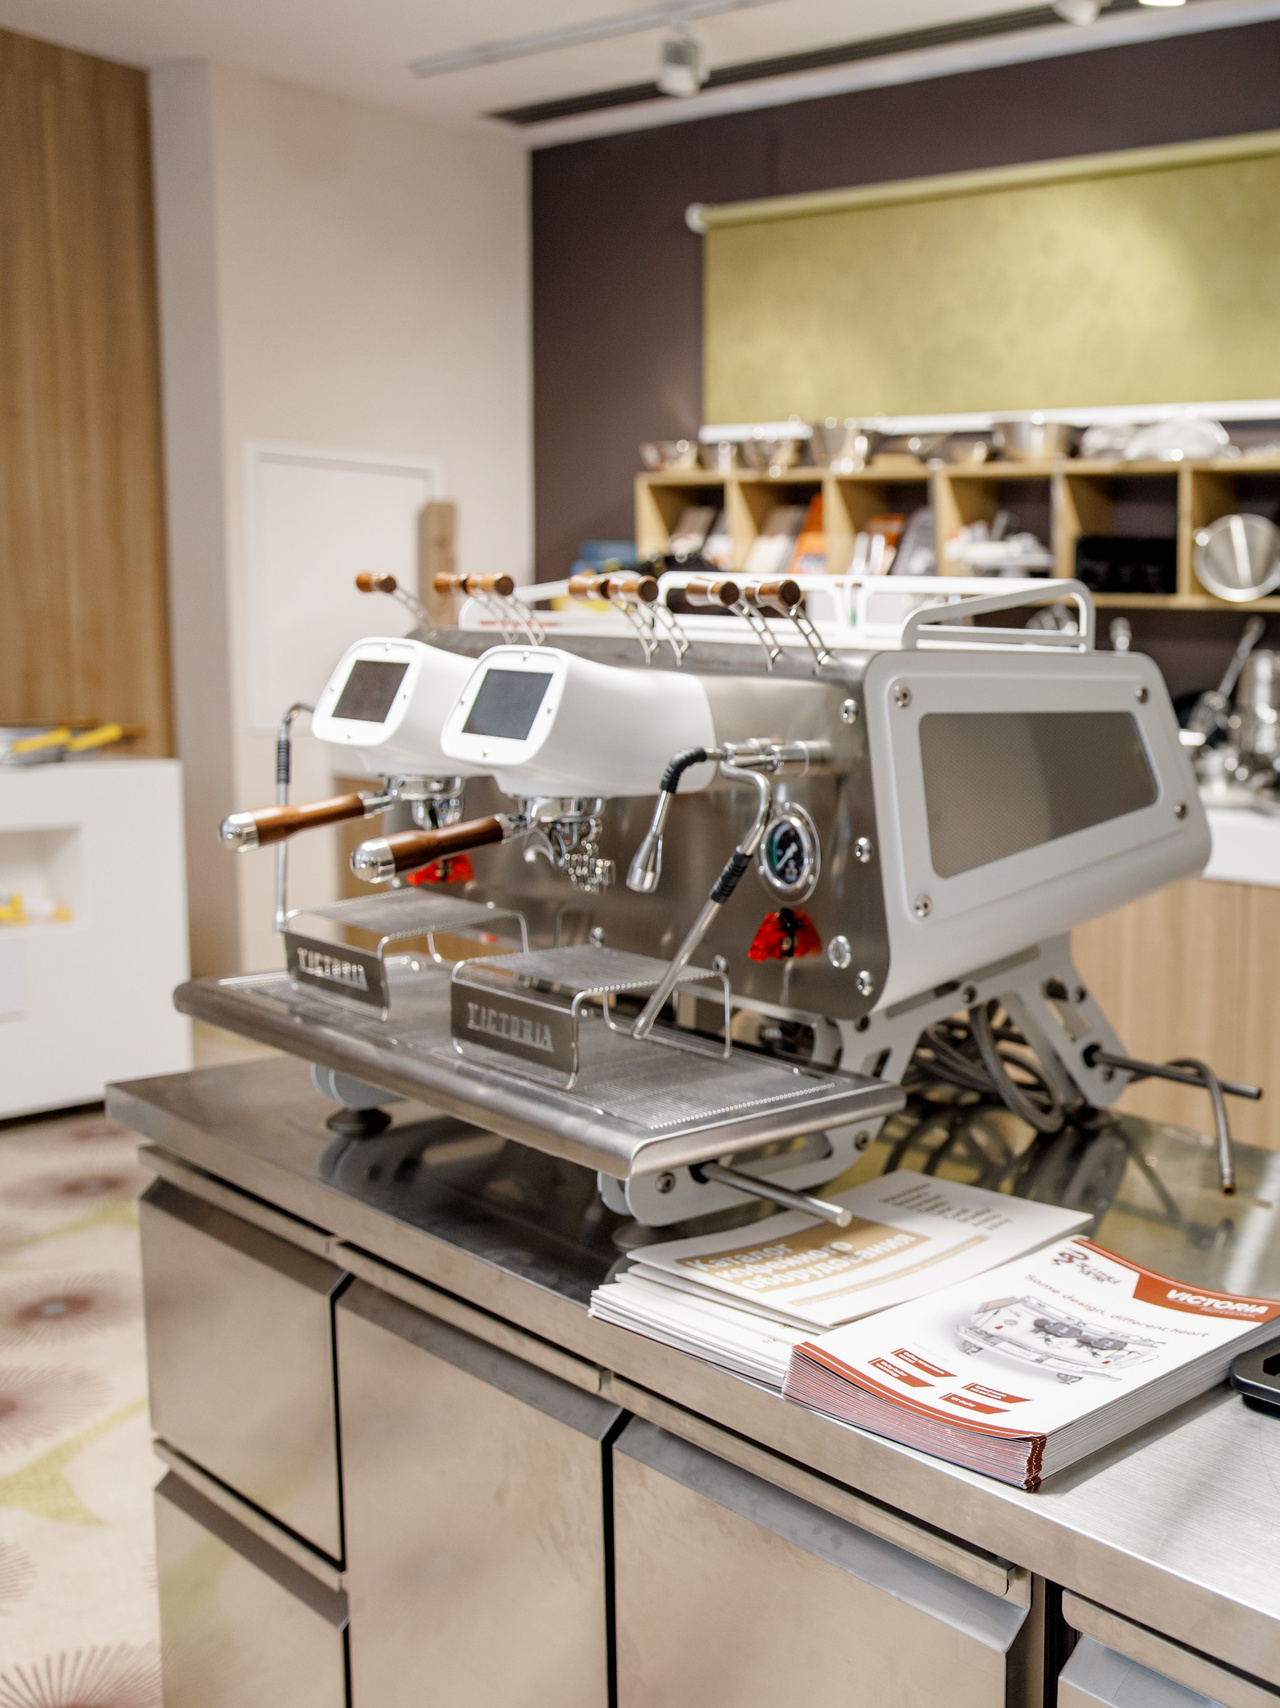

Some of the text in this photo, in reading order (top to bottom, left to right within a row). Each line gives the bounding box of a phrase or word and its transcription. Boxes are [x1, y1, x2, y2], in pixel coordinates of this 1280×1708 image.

[686, 1243, 792, 1271] Каталог
[715, 1241, 853, 1281] кофейного
[741, 1233, 916, 1290] оборудования
[1025, 1274, 1060, 1294] Same
[1110, 1313, 1168, 1332] different
[1170, 1327, 1209, 1338] heart
[1166, 1289, 1269, 1315] VICTORIA
